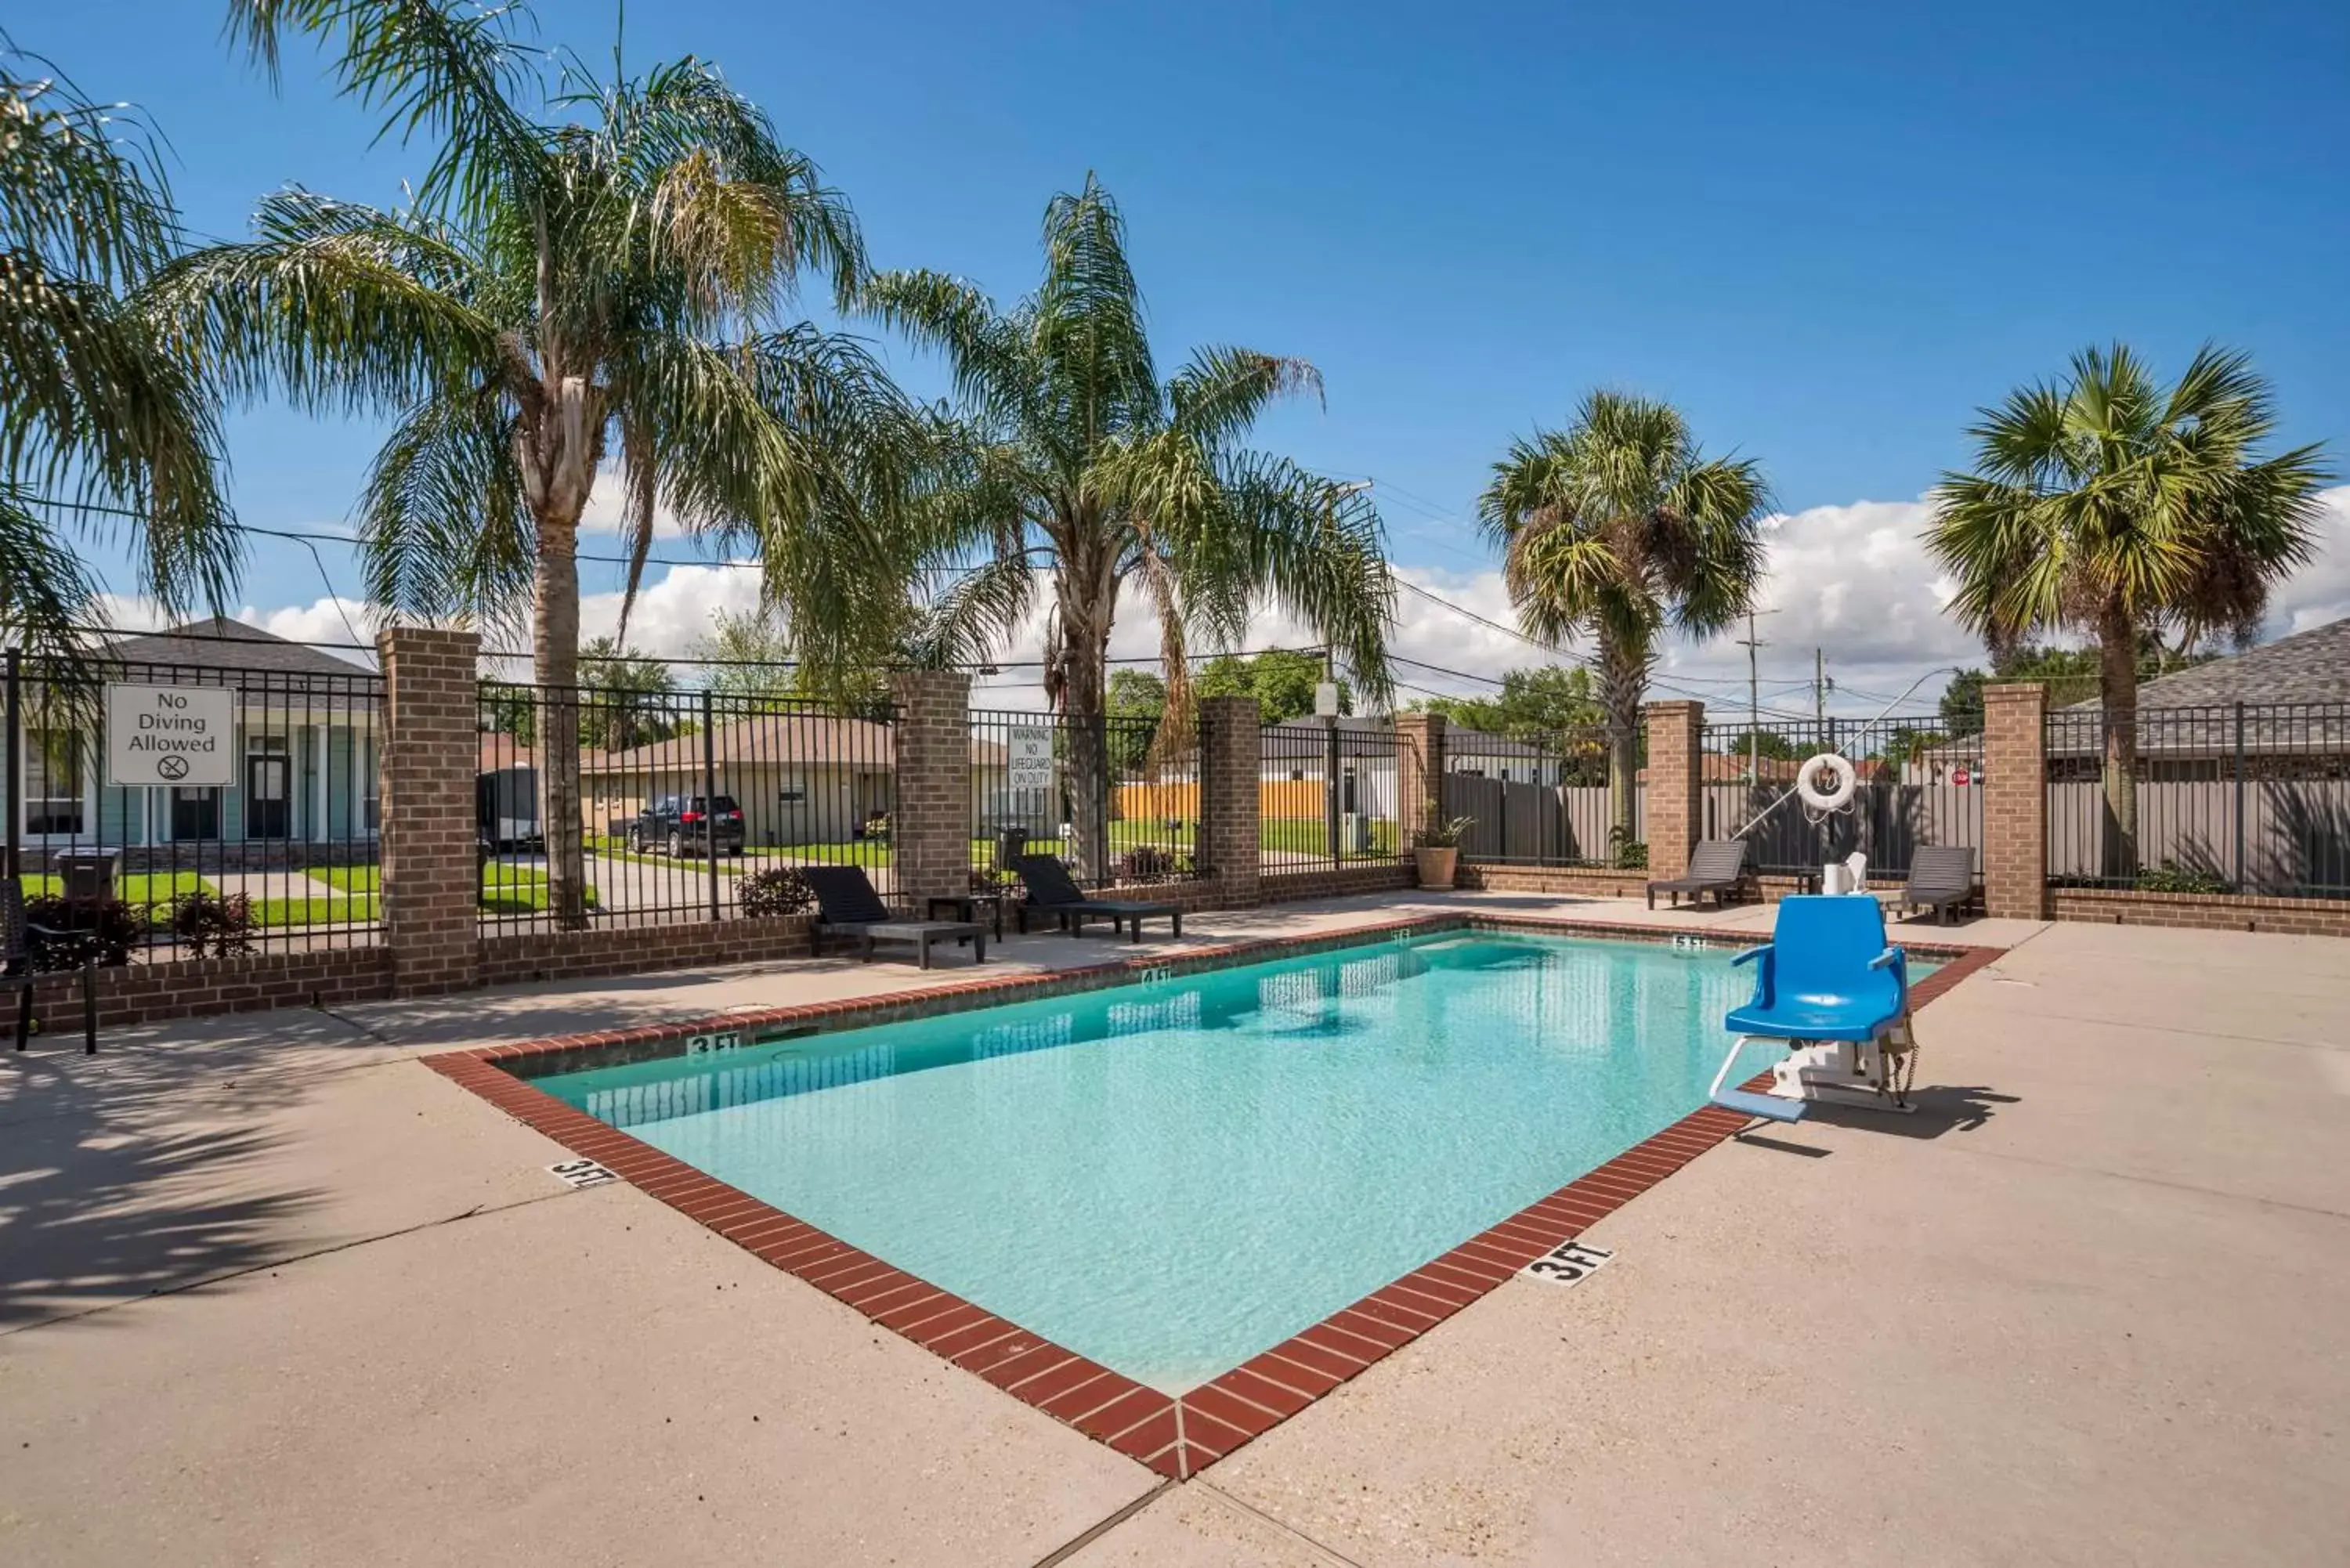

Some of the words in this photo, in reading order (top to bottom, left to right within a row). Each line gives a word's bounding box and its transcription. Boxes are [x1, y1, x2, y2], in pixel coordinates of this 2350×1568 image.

[158, 693, 187, 709] No
[139, 714, 206, 734] Diving
[1013, 728, 1050, 741] WARNING
[128, 735, 215, 753] Allowed
[1025, 743, 1038, 755] NO
[1010, 757, 1052, 770] LIFEGUARD
[1014, 772, 1027, 784] ON
[1027, 772, 1049, 784] DUTY
[692, 1037, 709, 1053] 3
[714, 1032, 738, 1050] FT
